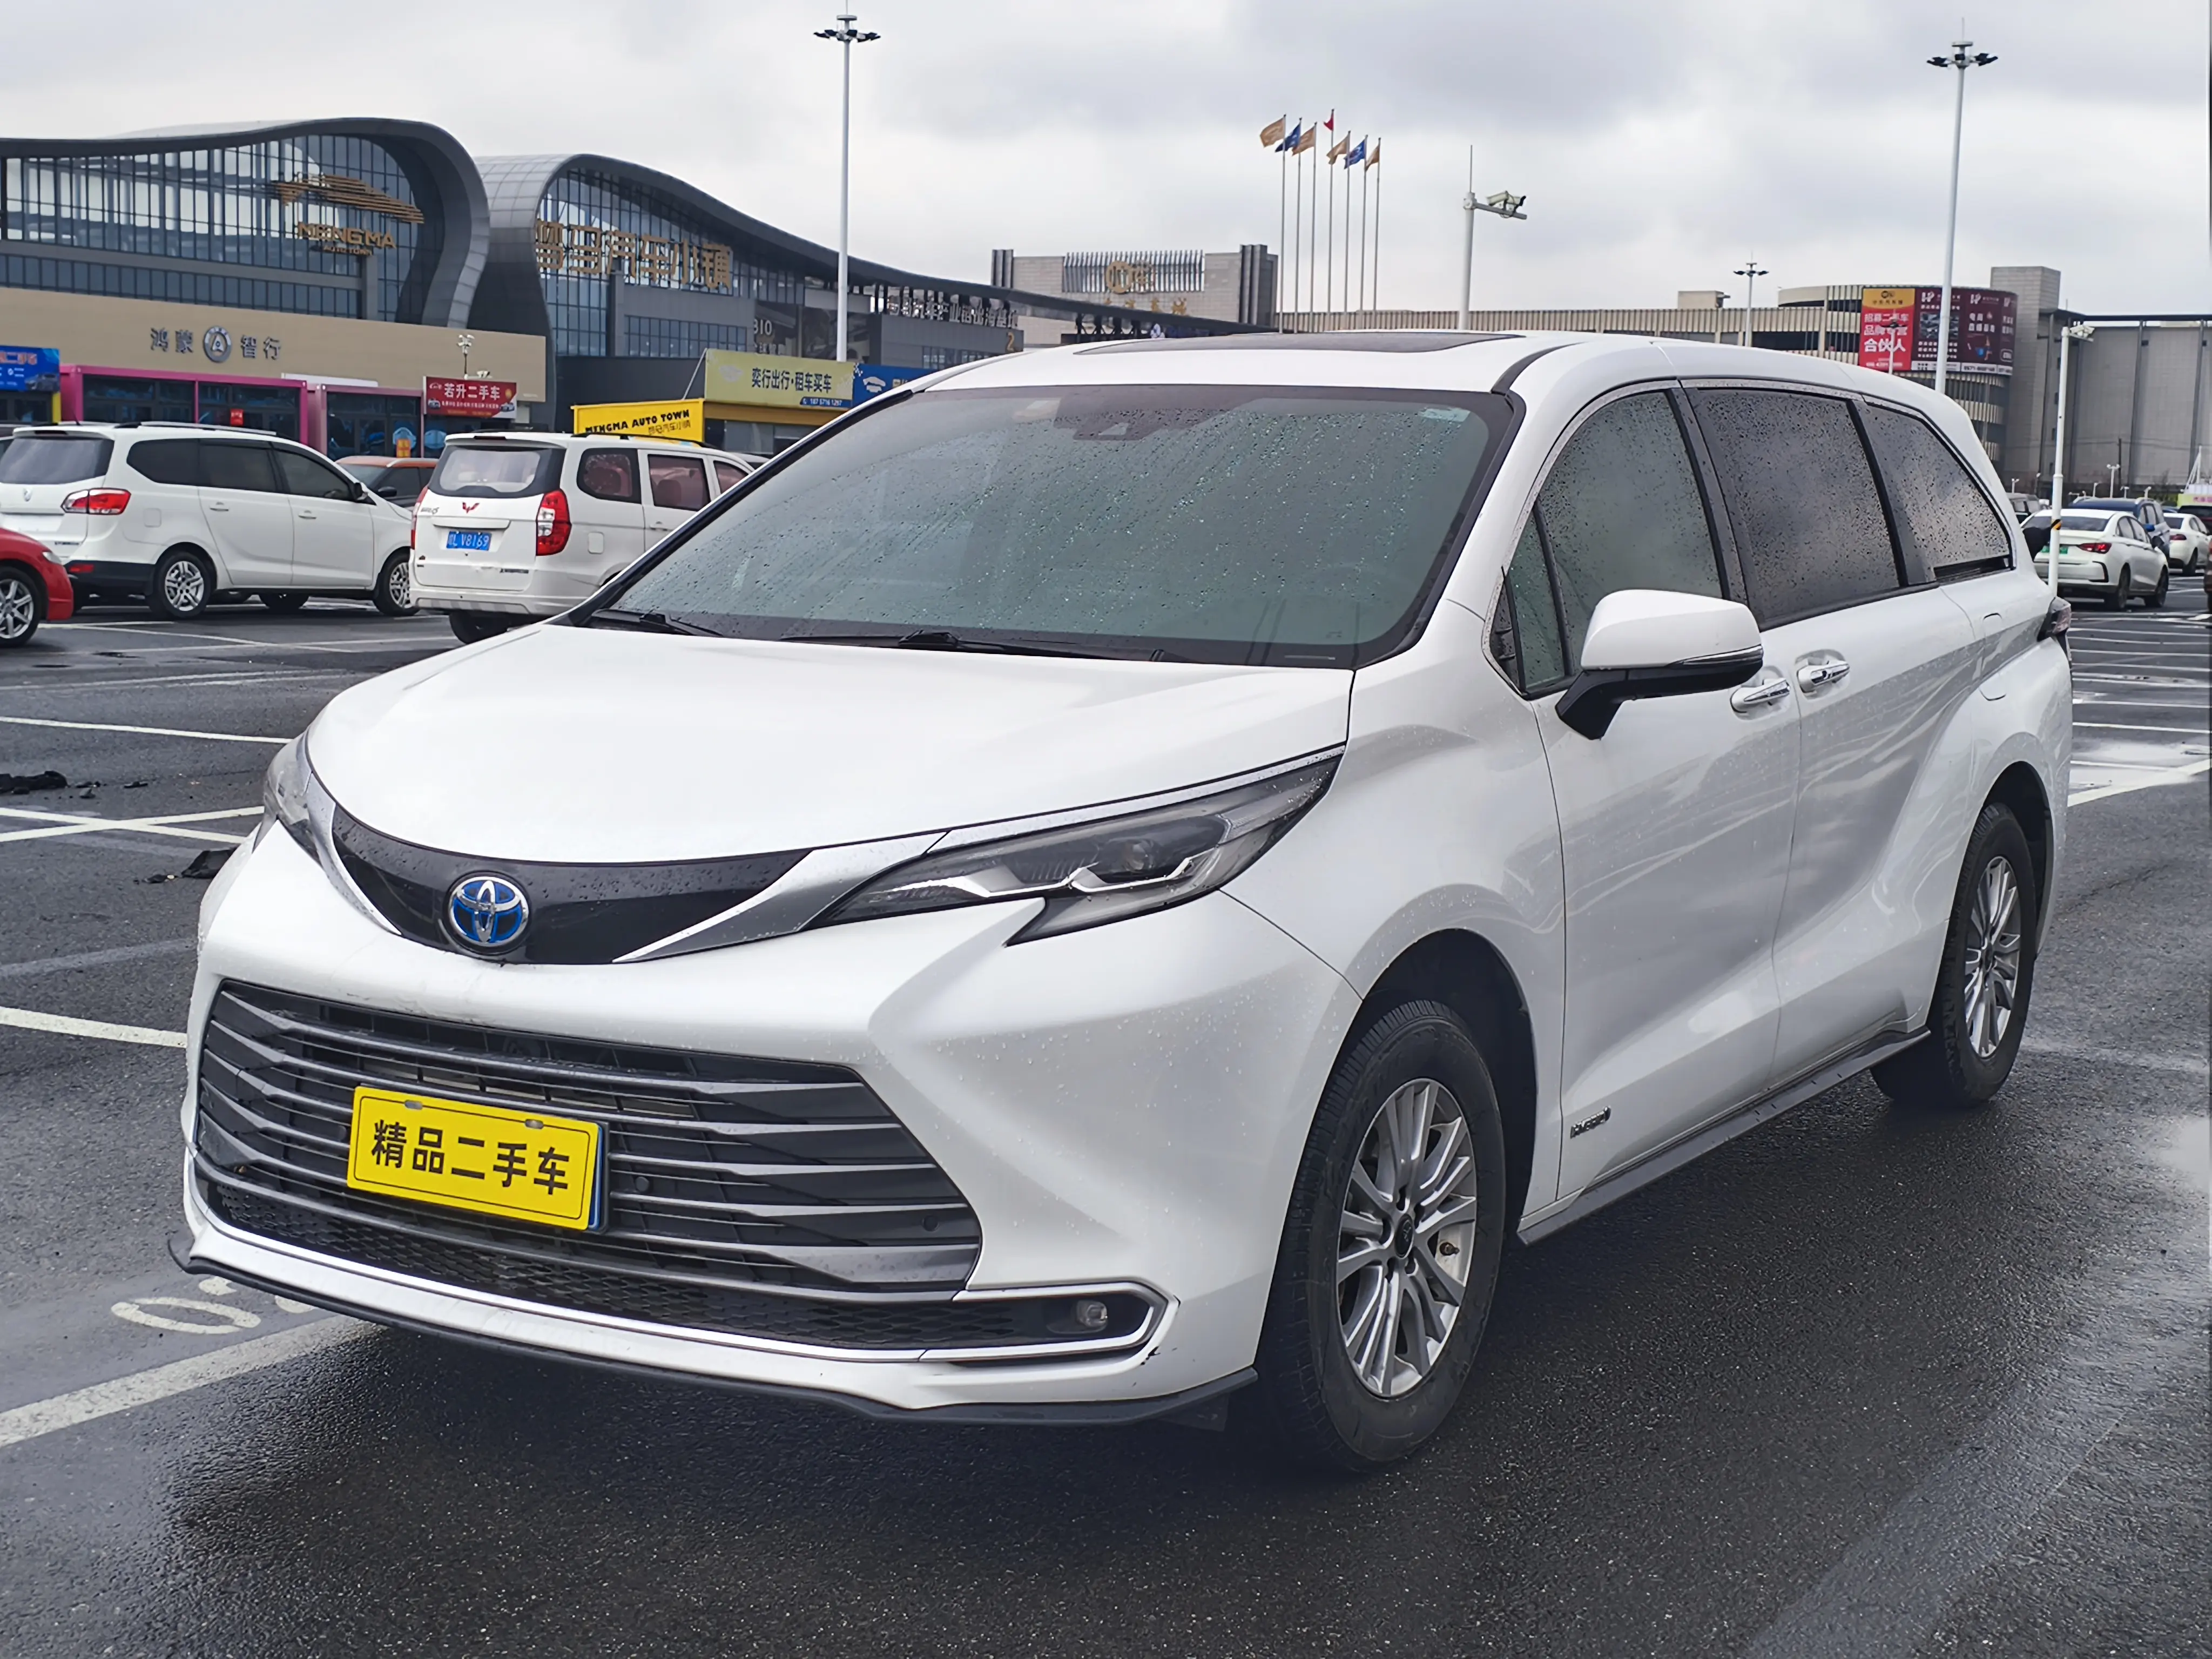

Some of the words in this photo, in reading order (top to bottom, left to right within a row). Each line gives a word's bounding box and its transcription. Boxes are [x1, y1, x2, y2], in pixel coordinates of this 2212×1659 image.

[150, 327, 193, 354] 鸿蒙
[240, 334, 281, 360] 智行
[1864, 338, 1906, 352] 合伙人
[632, 415, 658, 428] AUTO
[660, 409, 690, 421] TOWN
[371, 1119, 570, 1195] 精品二手车
